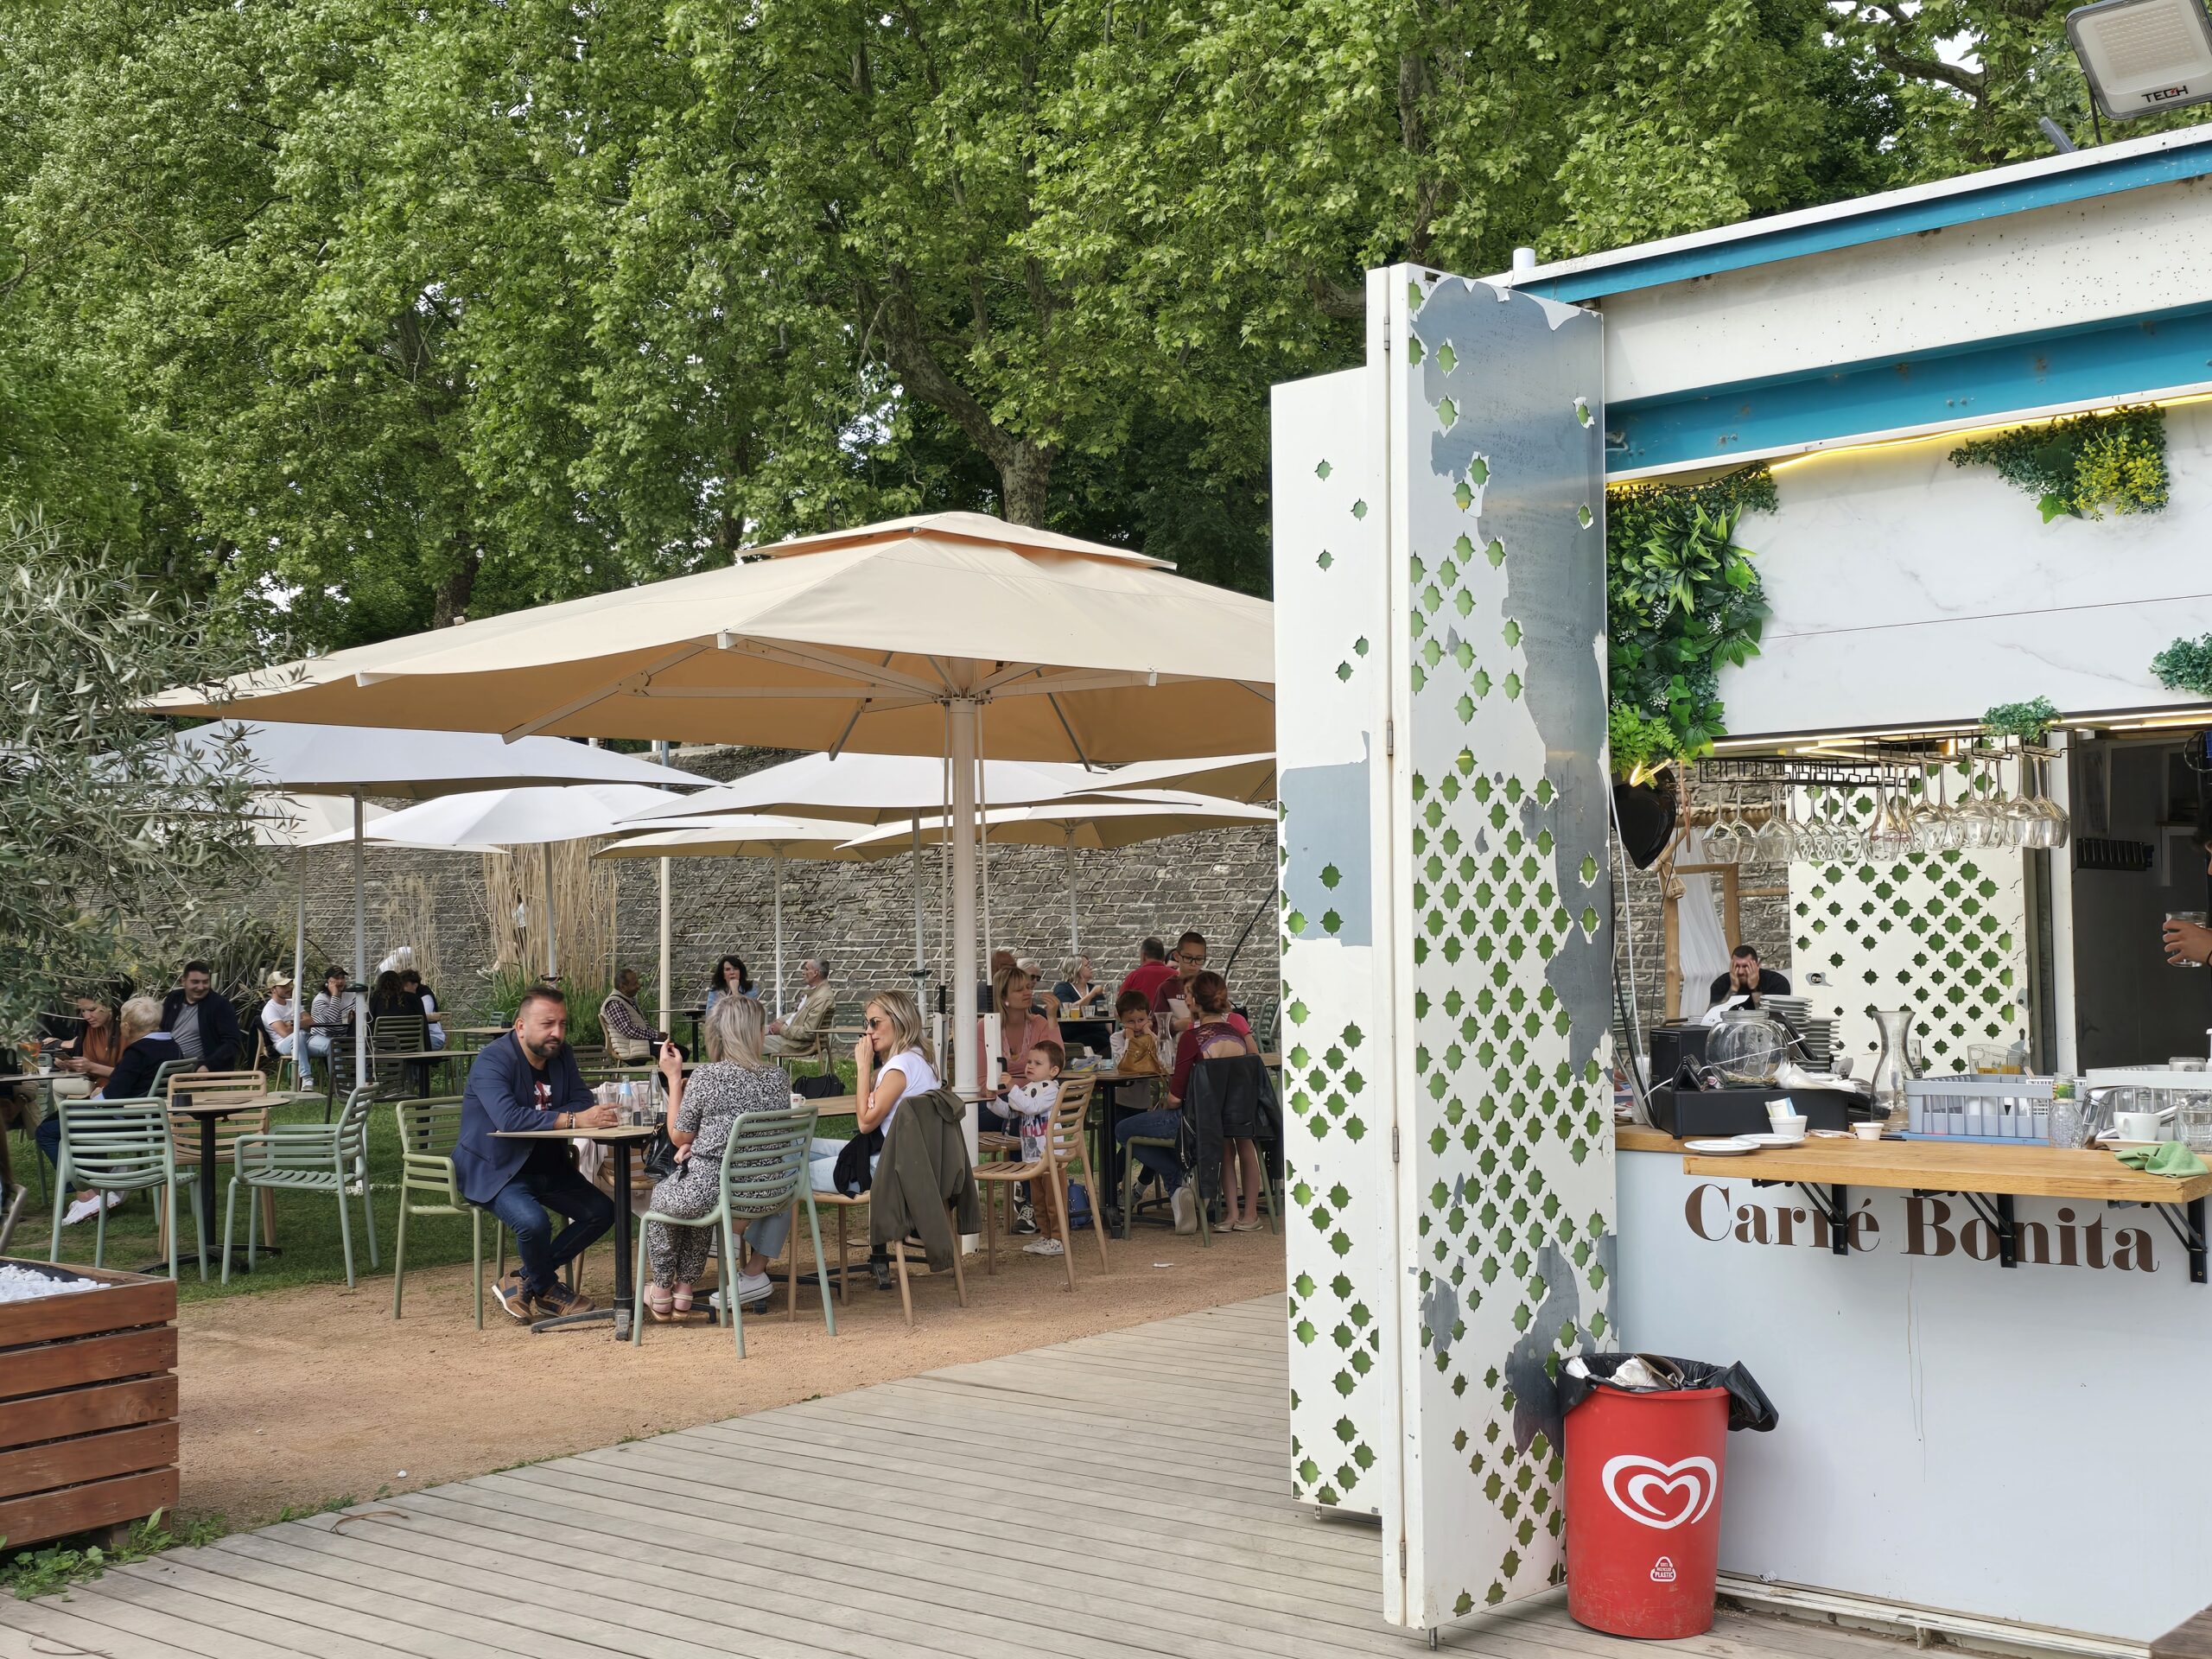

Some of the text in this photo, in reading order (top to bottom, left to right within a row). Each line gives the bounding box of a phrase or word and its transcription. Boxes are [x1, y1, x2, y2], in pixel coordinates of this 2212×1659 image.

[2141, 85, 2189, 103] TECH
[1685, 1183, 2159, 1273] Carré Bonita
